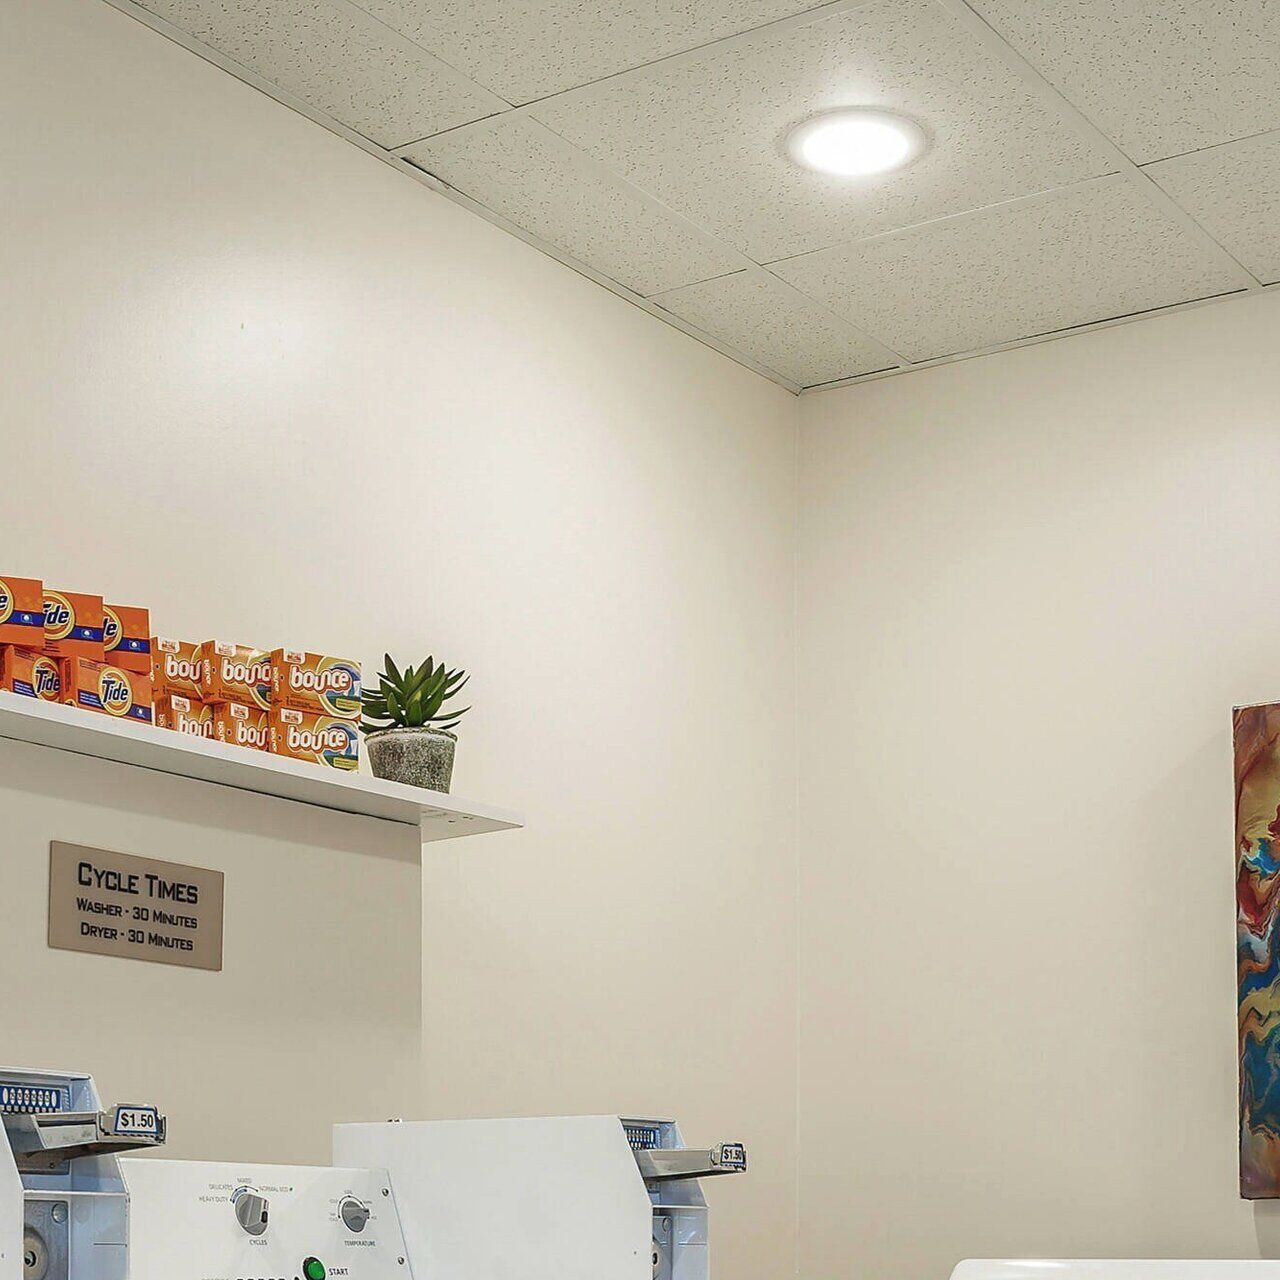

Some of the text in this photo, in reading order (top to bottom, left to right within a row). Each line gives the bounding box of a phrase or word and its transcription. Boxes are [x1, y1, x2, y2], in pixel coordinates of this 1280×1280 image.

[223, 659, 271, 684] bounc
[292, 666, 349, 691] bounce
[102, 679, 128, 704] Tide
[289, 726, 346, 751] bounce
[78, 862, 198, 904] CYCLE TIMES
[77, 897, 123, 917] WASHER
[132, 907, 149, 921] 30
[153, 910, 197, 929] MINUTES
[81, 922, 117, 940] DRYER
[128, 929, 144, 943] 30
[148, 933, 194, 951] MINUTES
[120, 1113, 154, 1128] $1.50
[329, 1268, 348, 1276] START
